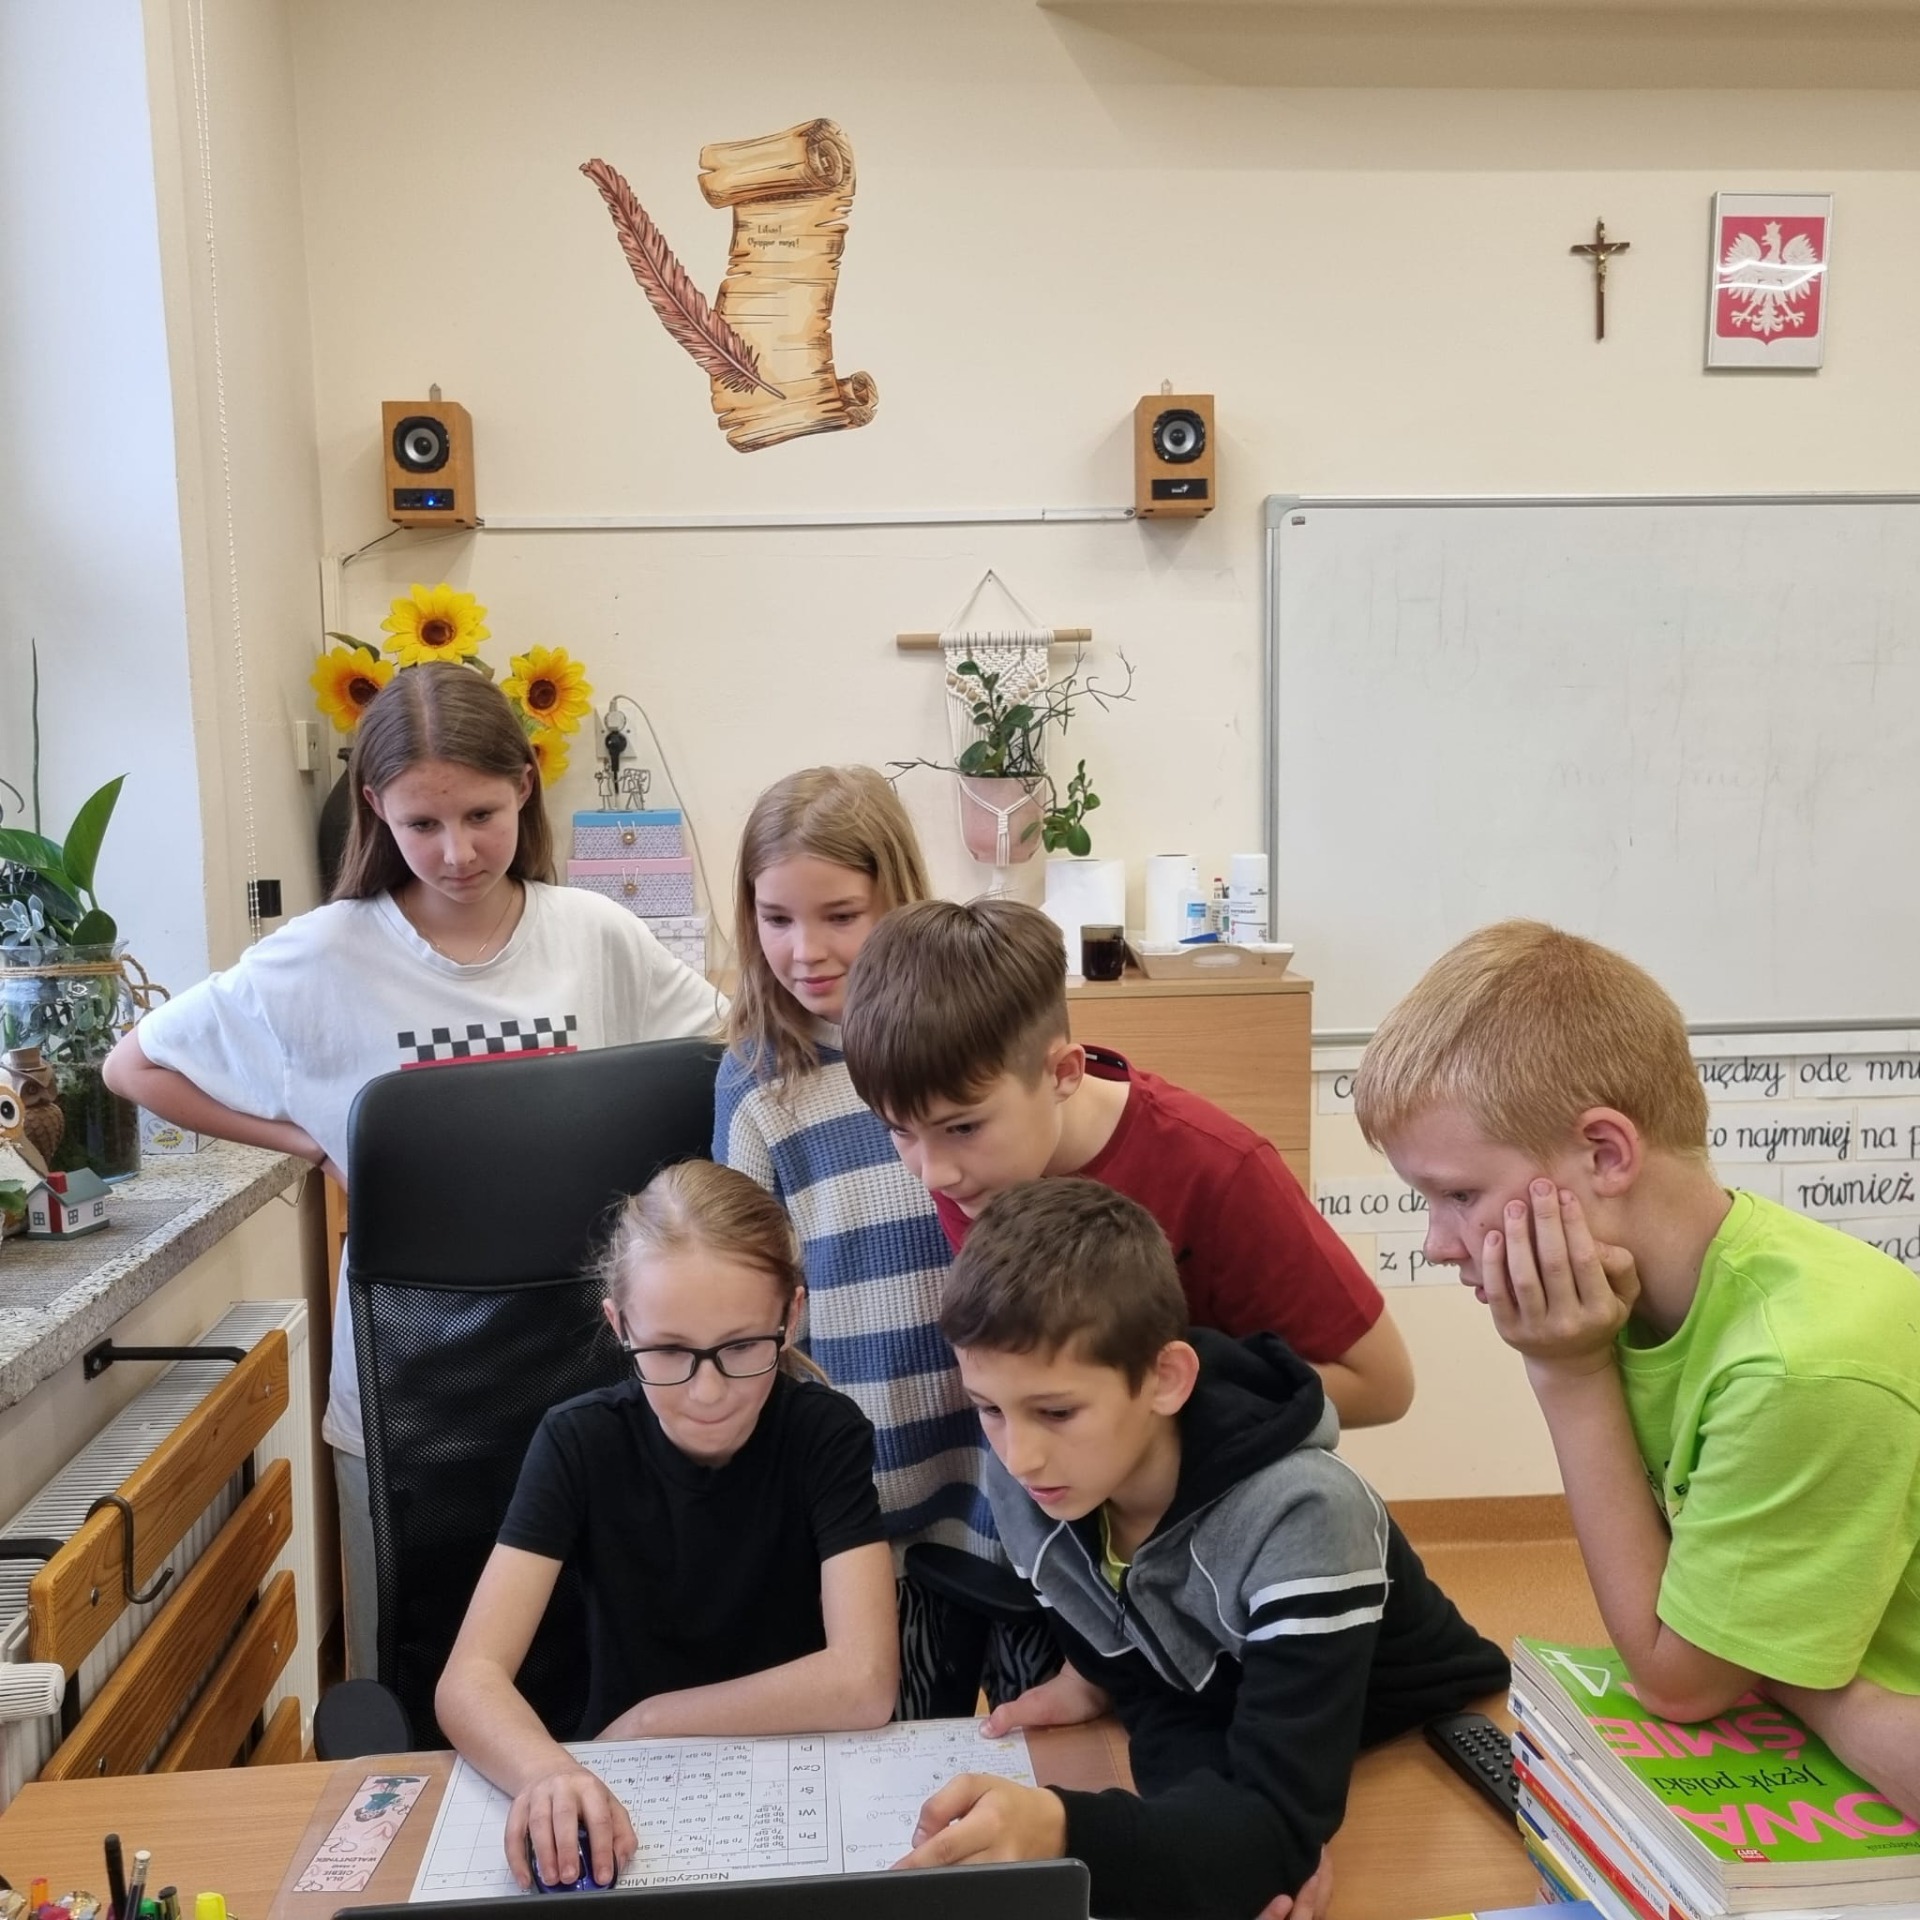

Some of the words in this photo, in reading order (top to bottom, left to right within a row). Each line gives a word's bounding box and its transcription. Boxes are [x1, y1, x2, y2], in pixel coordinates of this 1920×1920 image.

[1800, 1054, 1851, 1083] ode
[1736, 1120, 1851, 1161] najmniej
[1860, 1126, 1898, 1149] na
[1318, 1195, 1351, 1215] na
[1360, 1193, 1389, 1215] co
[1798, 1172, 1915, 1209] również
[1379, 1251, 1398, 1271] z
[1538, 1647, 1611, 1697] 4
[800, 1744, 813, 1752] Pi
[792, 1764, 821, 1772] Czw
[1747, 1763, 1828, 1794] Język
[1650, 1770, 1741, 1797] polski
[798, 1808, 817, 1816] Wt
[798, 1832, 817, 1840] Pn
[653, 1872, 729, 1885] Nauczyciel
